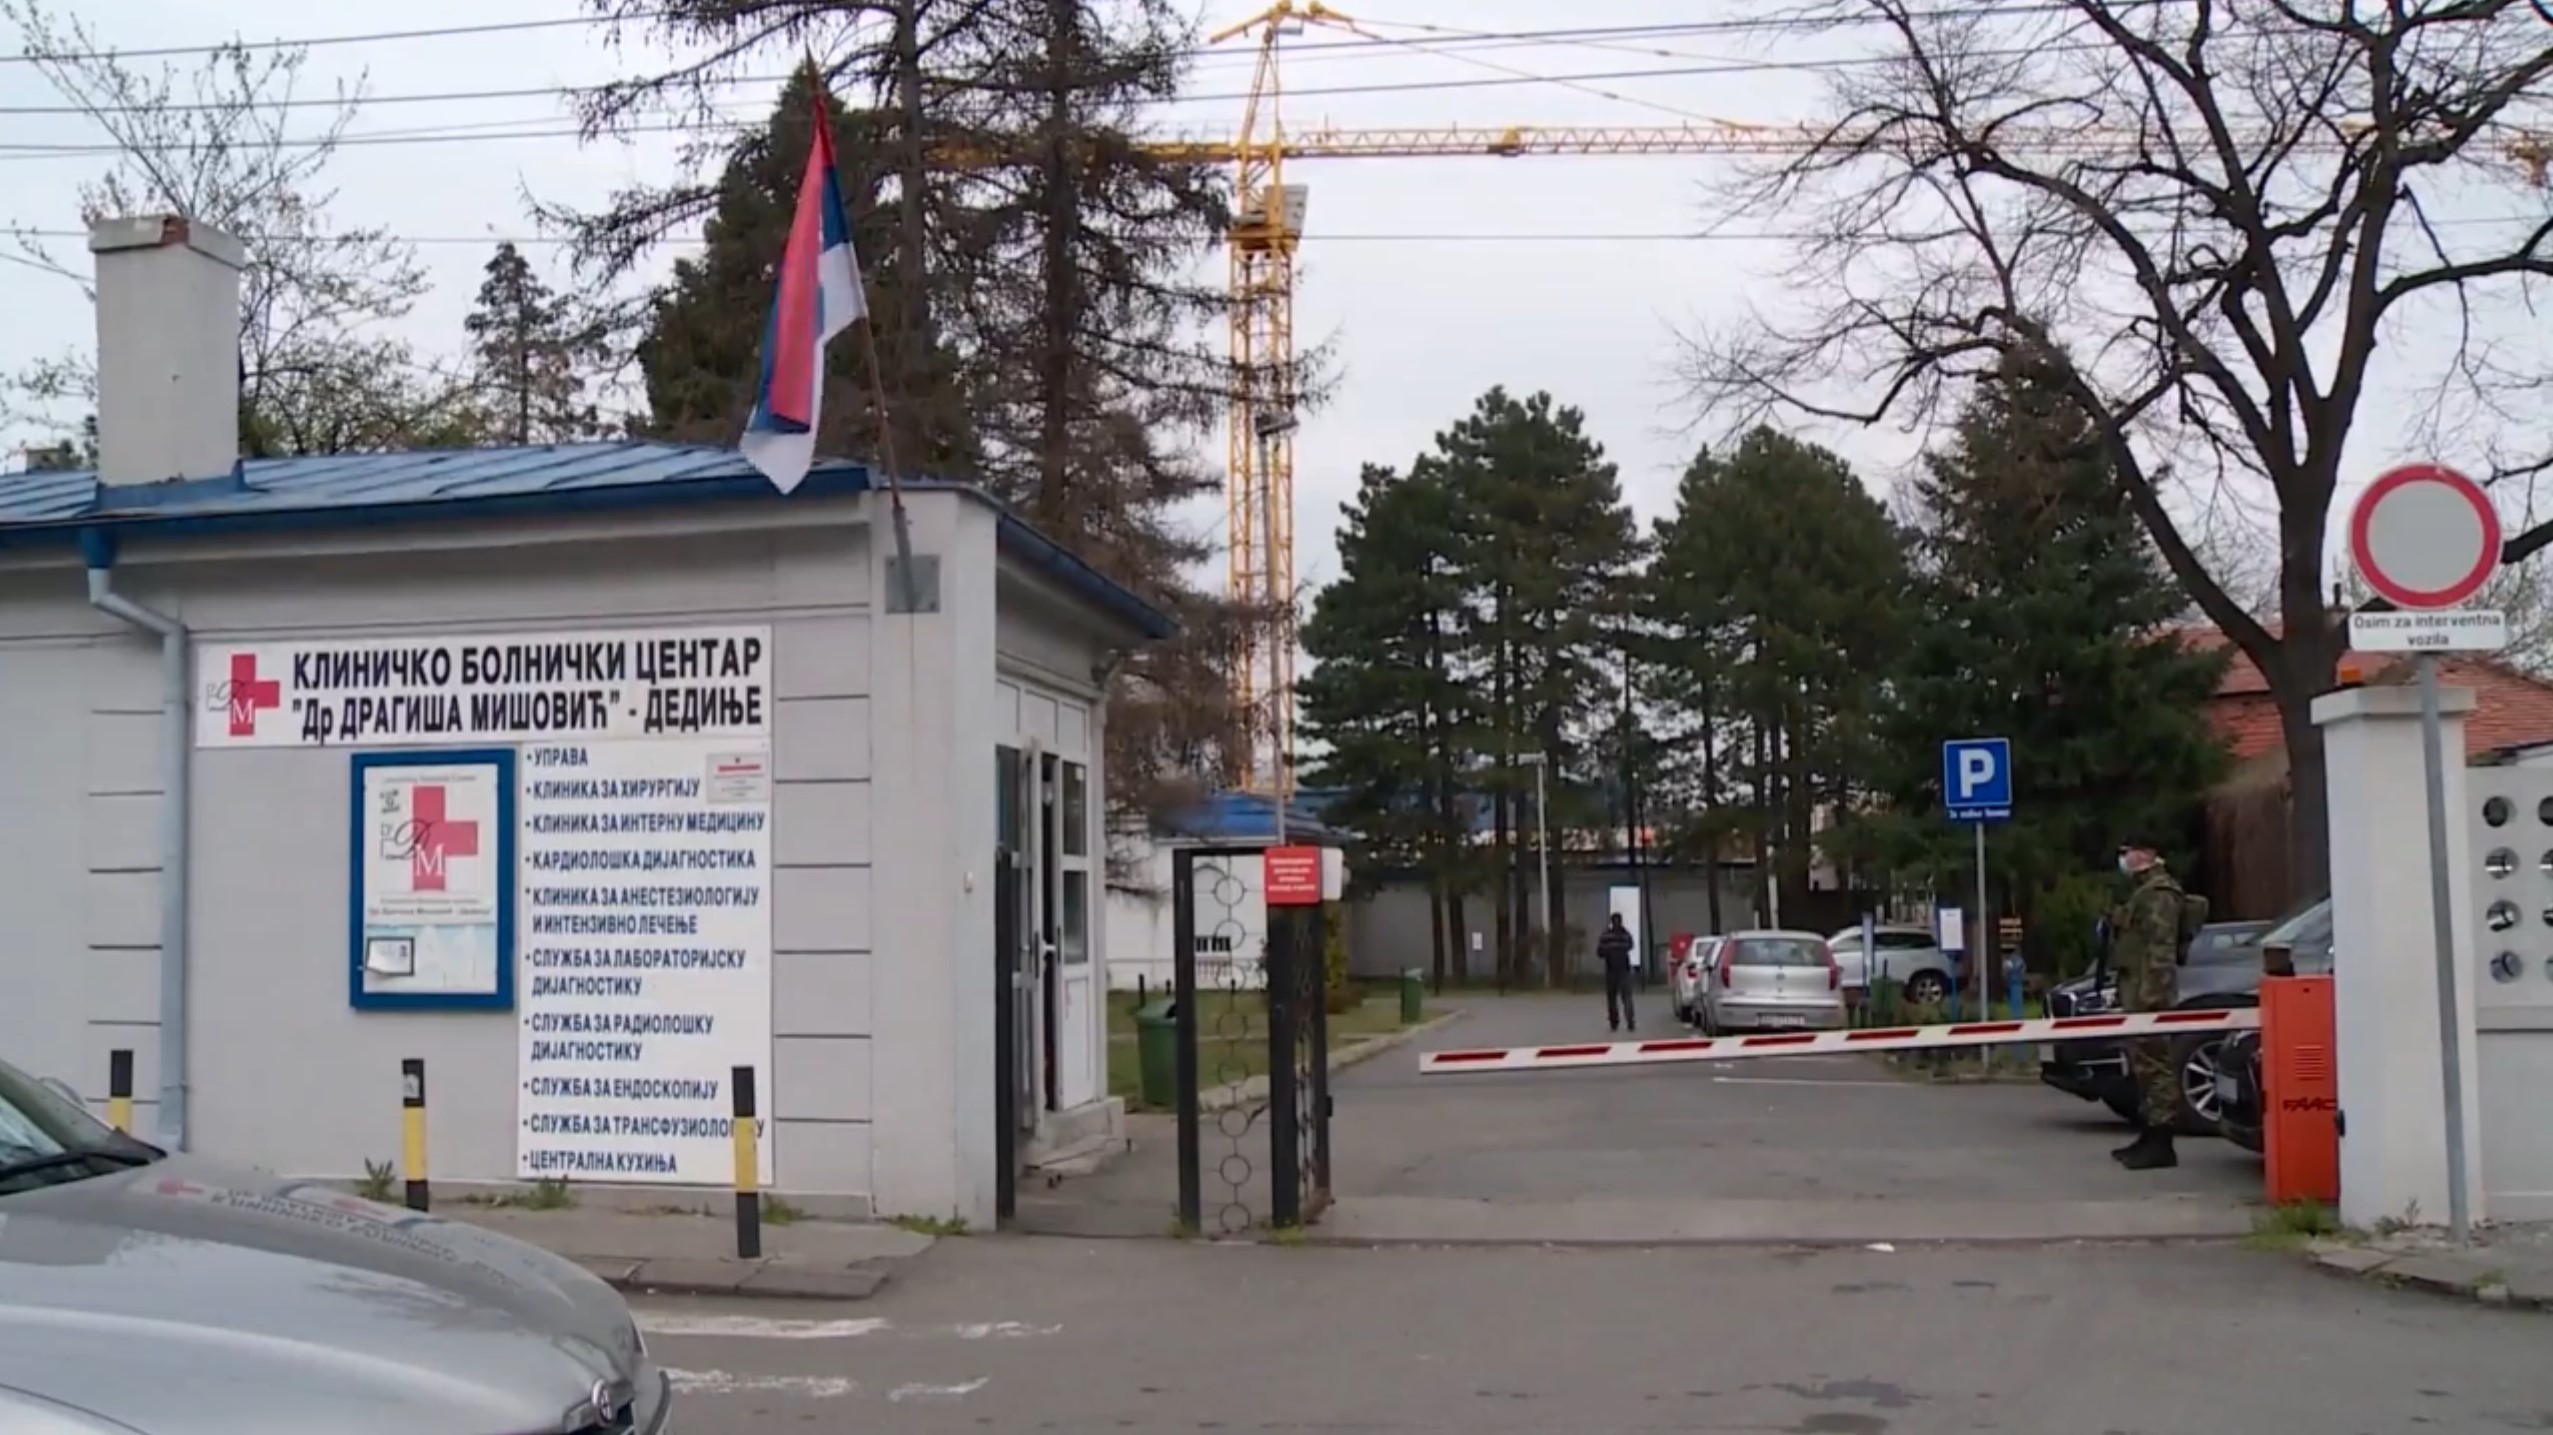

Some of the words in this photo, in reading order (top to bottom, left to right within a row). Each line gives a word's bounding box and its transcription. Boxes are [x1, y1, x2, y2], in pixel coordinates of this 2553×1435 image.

[2354, 616, 2390, 629] Osim
[2394, 617, 2412, 629] za
[2415, 614, 2500, 627] interventna
[2407, 632, 2450, 646] vozila
[293, 649, 451, 690] КЛИНИЧКО
[462, 642, 626, 685] БОЛНИЧКИ
[636, 637, 761, 684] ЦЕНТАР
[340, 694, 463, 740] ДРАГИША
[644, 686, 762, 733] ДЕДИЊЕ
[533, 748, 588, 767] УПРАВА
[1959, 748, 1996, 799] P
[532, 781, 600, 800] КЛИНИКА
[601, 780, 617, 798] ЗА
[621, 778, 700, 798] ХИРУРГИЈУ
[532, 814, 600, 833] КЛИНИКА
[601, 814, 618, 832] ЗА
[621, 813, 684, 832] ИНТЕРНУ
[686, 811, 765, 834] МЕДИЦИНУ
[532, 851, 640, 871] КАРДИОЛОШКА
[643, 849, 756, 870] ДИЈАГНОСТИКА
[532, 887, 600, 906] КЛИНИКА
[601, 887, 618, 905] ЗА
[621, 886, 759, 906] АНЕСТЕЗИОЛОГИЈУ
[532, 915, 542, 934] И
[544, 914, 636, 934] ИНТЕНЗИВНО
[638, 914, 698, 934] ЛЕЧЕЊЕ
[532, 948, 592, 968] СЛУЖБА
[594, 949, 610, 968] ЗА
[613, 948, 746, 969] ЛАБОРАТОРИЈСКУ
[531, 975, 643, 997] ДИЈАГНОСТИКУ
[531, 1012, 592, 1032] СЛУЖБА
[593, 1013, 610, 1032] ЗА
[613, 1014, 714, 1035] РАДИОЛОШКУ
[531, 1040, 643, 1061] ДИЈАГНОСТИКУ
[530, 1077, 591, 1096] СЛУЖБА
[593, 1078, 610, 1096] ЗА
[613, 1080, 719, 1100] ЕНДОСКОПИЈУ
[530, 1114, 591, 1134] СЛУЖБА
[593, 1115, 610, 1134] ЗА
[530, 1150, 614, 1172] ЦЕНТРАЛНА
[616, 1153, 678, 1173] КУХИЊА
